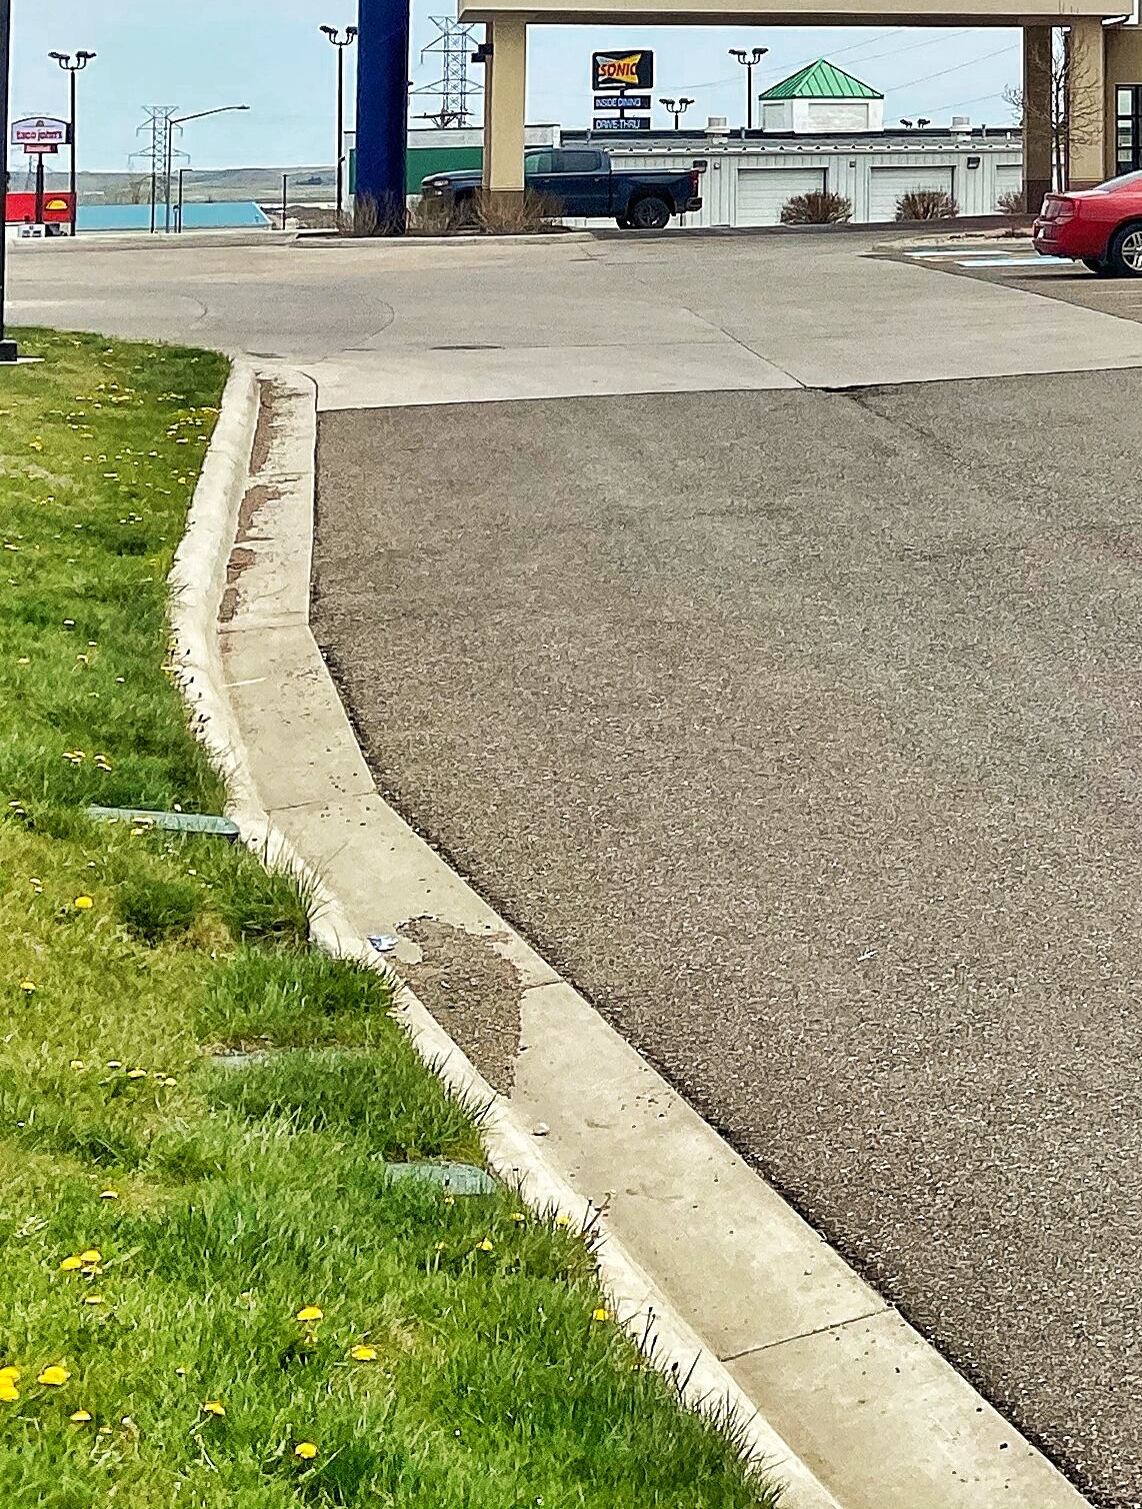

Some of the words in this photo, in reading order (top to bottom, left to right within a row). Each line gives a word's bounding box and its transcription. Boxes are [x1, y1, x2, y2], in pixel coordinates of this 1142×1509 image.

[598, 63, 637, 76] SONIC
[595, 97, 617, 107] INSIDE
[595, 119, 641, 129] DRIVE-THRU
